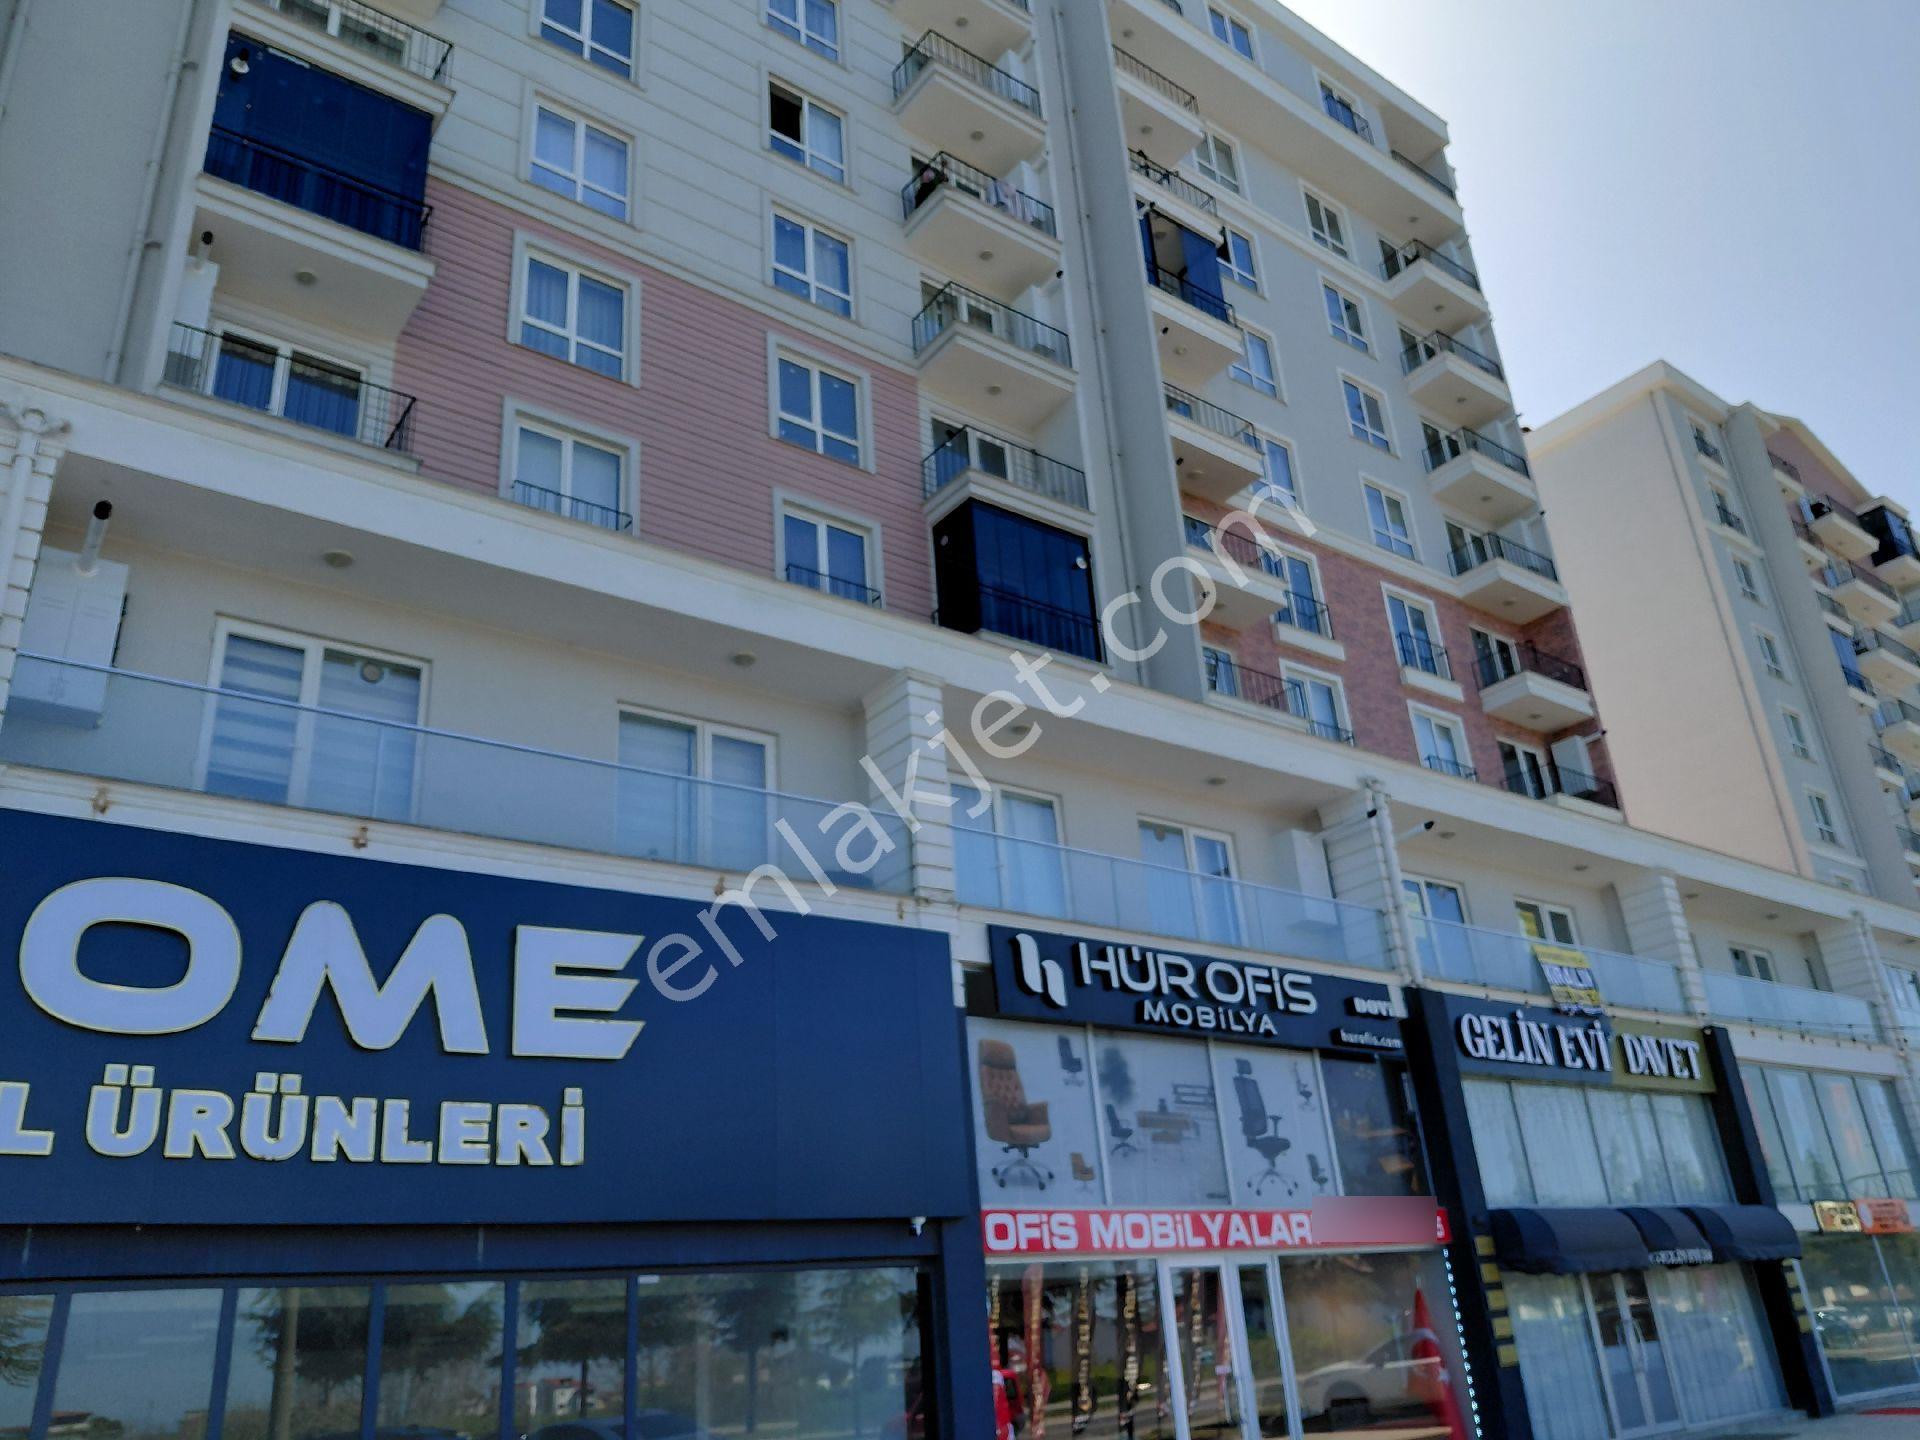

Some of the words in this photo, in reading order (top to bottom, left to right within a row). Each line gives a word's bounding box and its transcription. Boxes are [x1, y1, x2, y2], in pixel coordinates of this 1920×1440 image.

[1078, 941, 1199, 999] HÜR
[1205, 961, 1318, 1014] OFİS
[1143, 999, 1278, 1035] MOBİLYA
[1460, 1008, 1555, 1066] GELİN
[1556, 1019, 1613, 1072] EVİ
[86, 1063, 586, 1166] ÜRÜNLERİ
[1088, 1211, 1314, 1249] MOBİLYALAR
